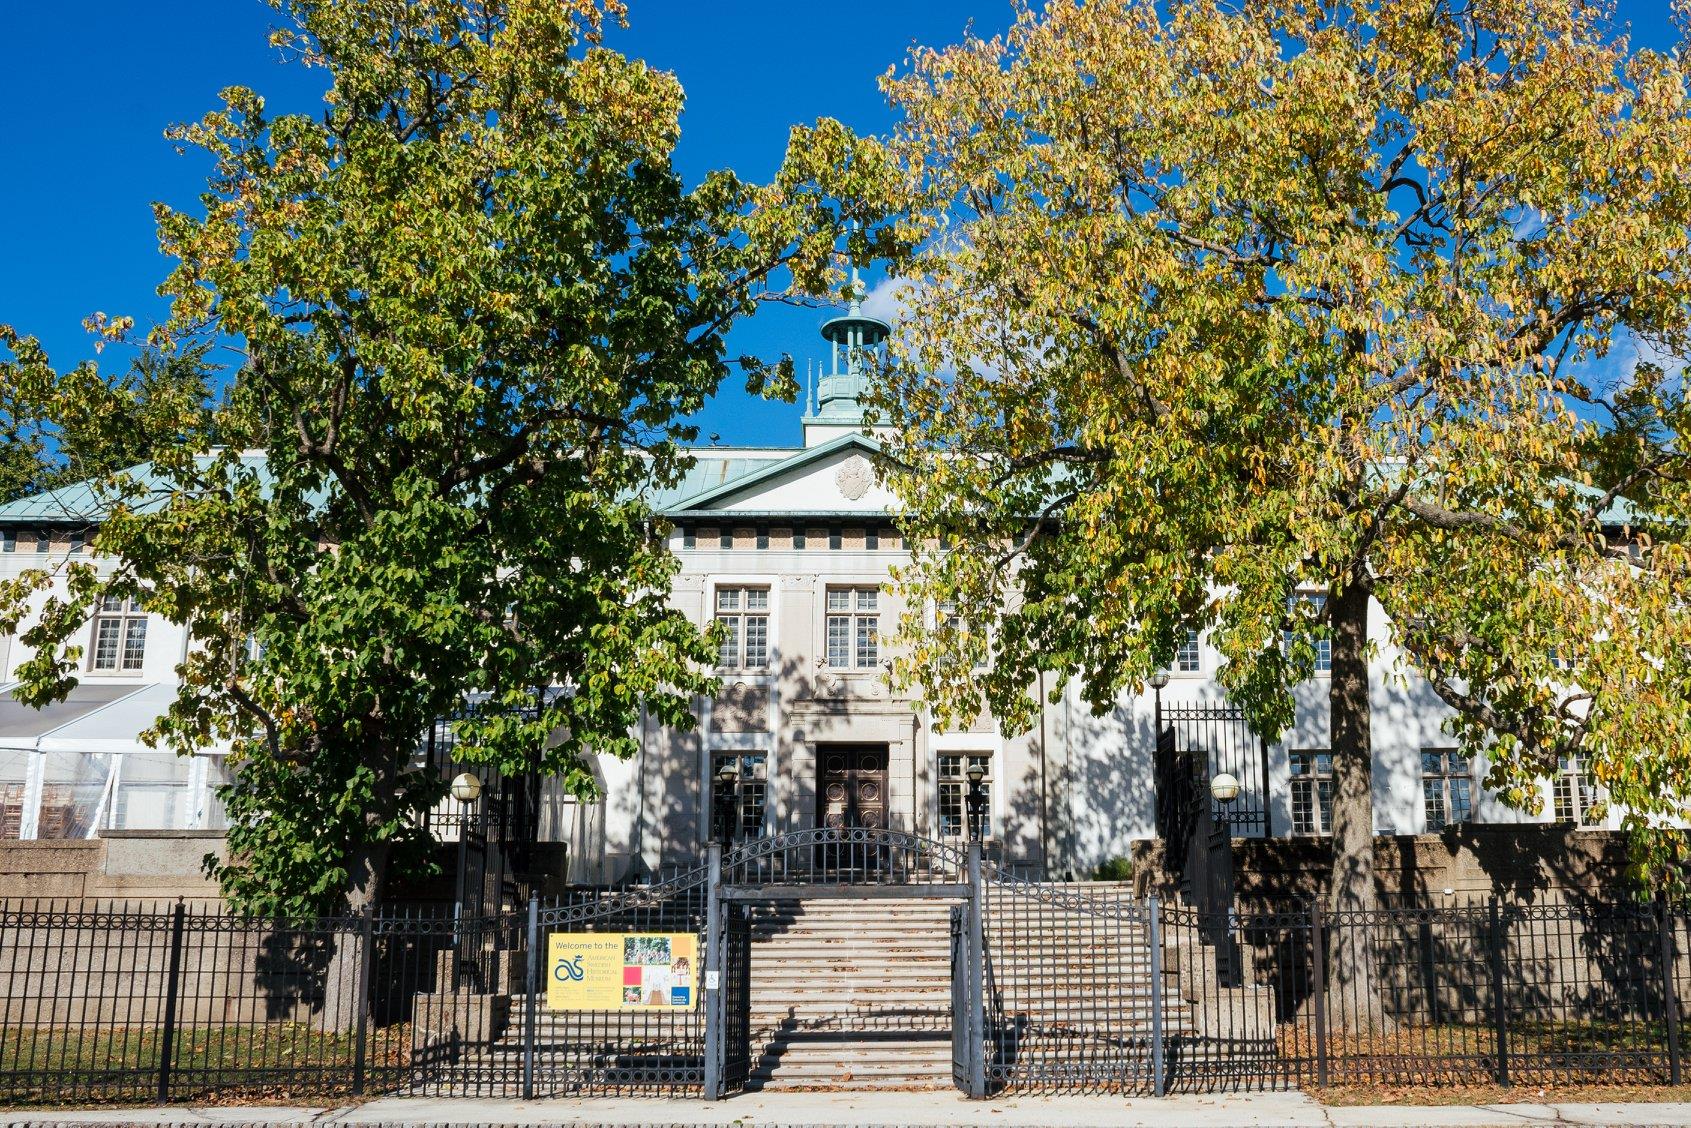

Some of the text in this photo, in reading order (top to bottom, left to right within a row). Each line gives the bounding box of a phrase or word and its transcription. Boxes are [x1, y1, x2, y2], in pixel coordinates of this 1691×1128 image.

[555, 942, 619, 950] Welcome to the
